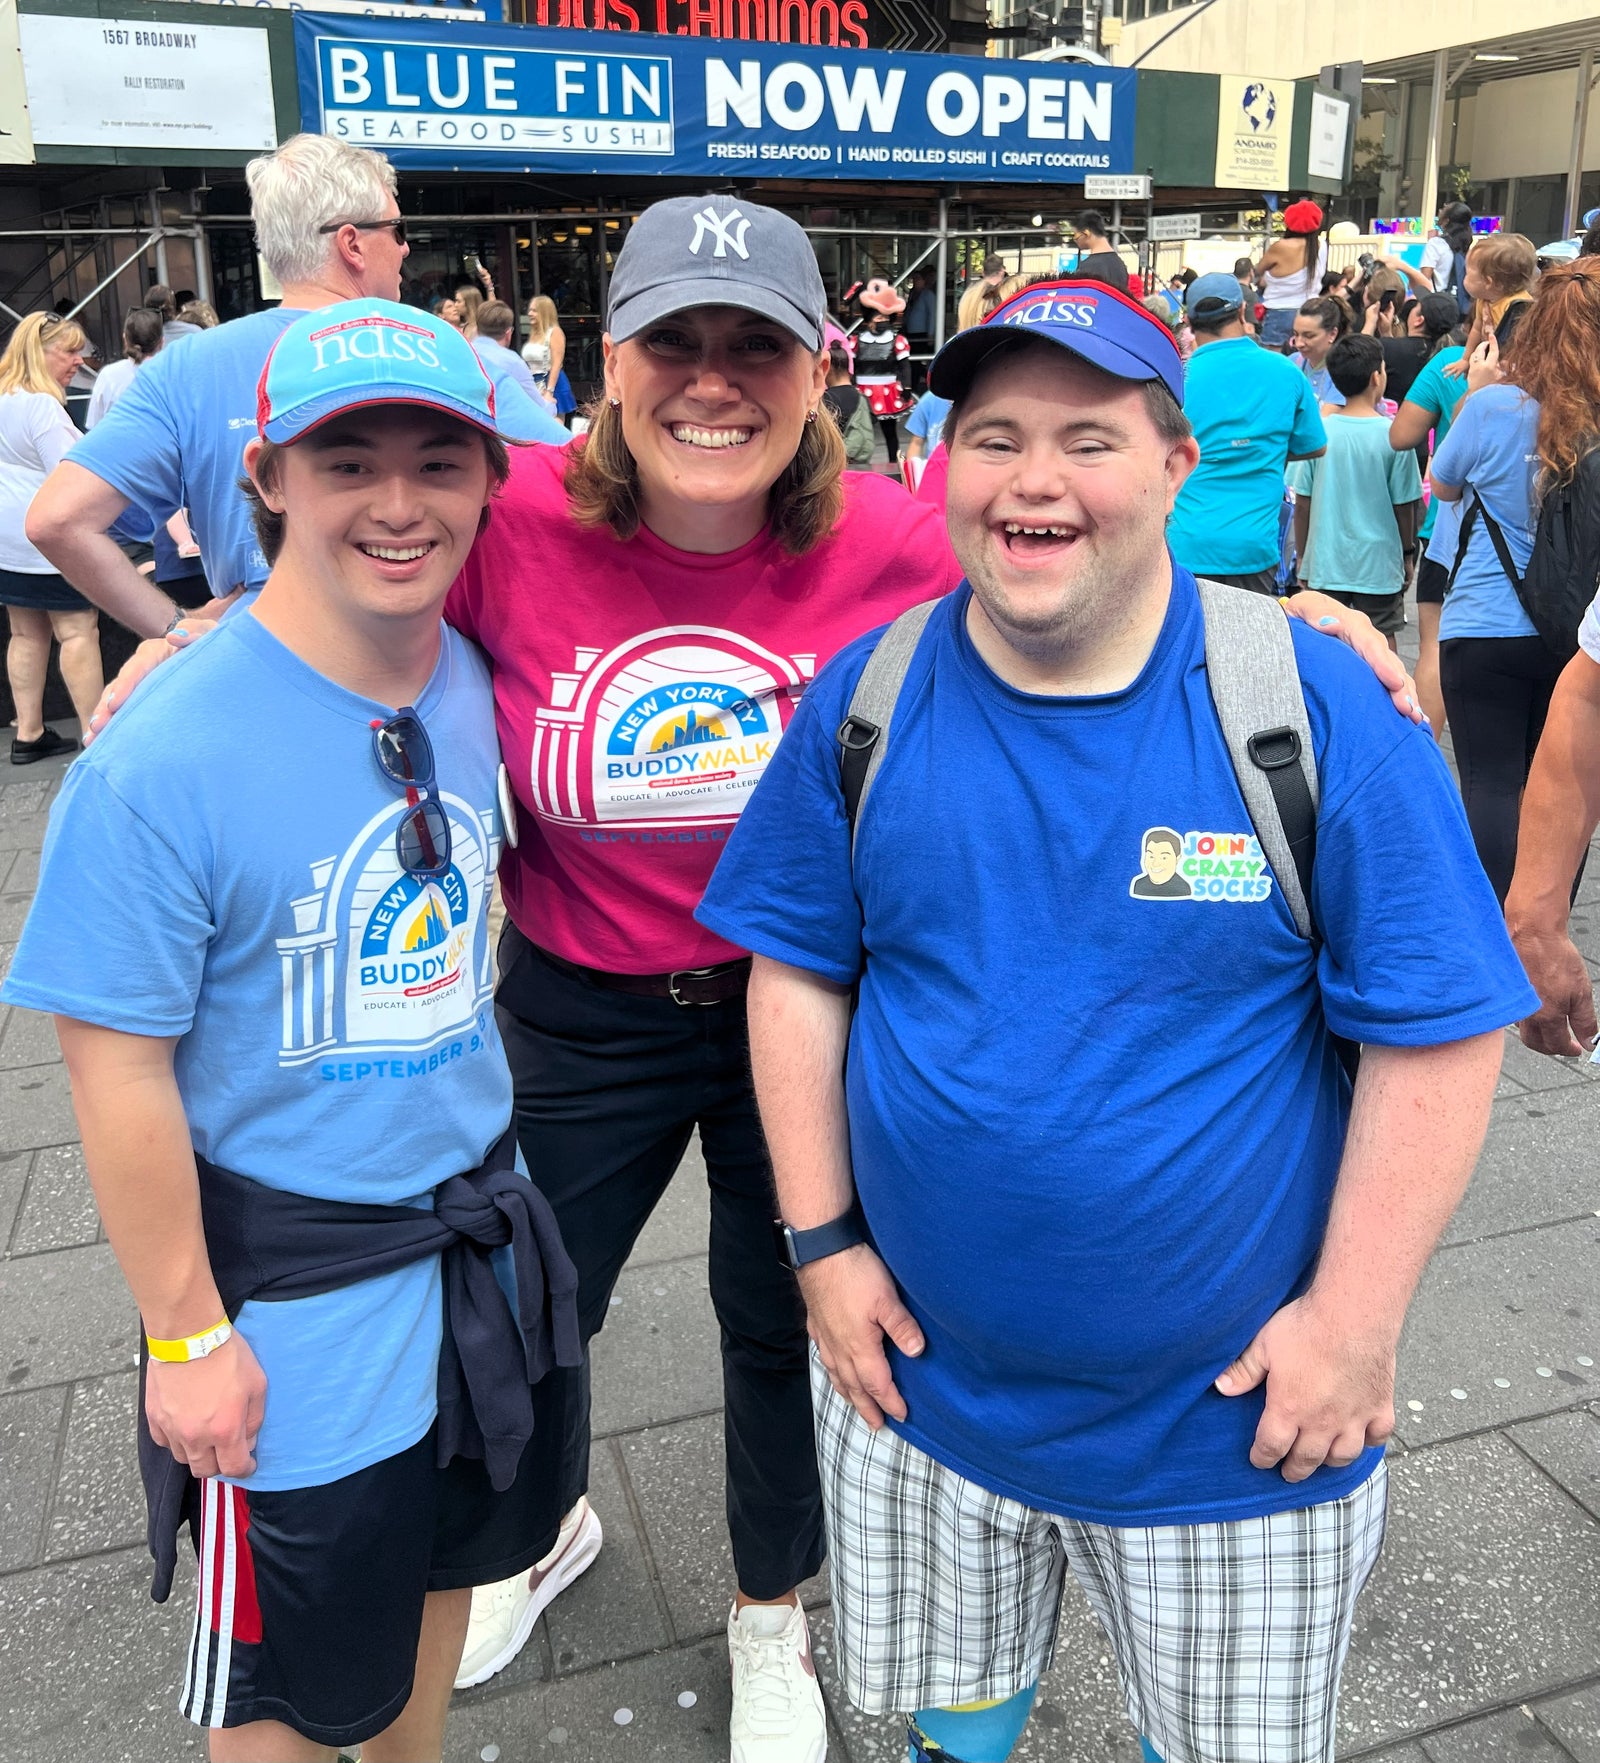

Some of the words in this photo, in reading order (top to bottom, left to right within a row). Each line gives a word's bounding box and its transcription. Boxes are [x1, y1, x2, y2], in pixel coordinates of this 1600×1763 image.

[103, 29, 129, 45] 1567
[135, 31, 198, 49] BROADWAY
[124, 76, 142, 89] RALLY
[144, 77, 186, 91] RESTORATION
[329, 47, 518, 111] BLUE
[555, 59, 661, 117] FIN
[704, 58, 907, 133] NOW
[926, 70, 1113, 142] OPEN
[336, 117, 516, 142] SEAFOOD
[562, 125, 662, 147] SUSHI
[707, 142, 758, 159] FRESH
[759, 143, 831, 161] SEAFOOD
[848, 147, 891, 162] HAND
[893, 148, 946, 164] ROLLED
[948, 150, 987, 165] SUSHI
[1001, 152, 1042, 167] CRAFT
[1044, 153, 1110, 169] COCKTAILS
[688, 206, 751, 260] NY
[617, 696, 659, 742] NEW
[666, 686, 728, 703] YORK
[610, 792, 652, 802] EDUCATE
[665, 786, 713, 798] ADVOCATE
[579, 829, 726, 844] SEPTEMBER
[1182, 858, 1261, 878] CRAZY
[1194, 878, 1267, 898] SOCKS
[368, 885, 408, 941] NEW
[443, 872, 463, 912] CITY
[364, 1001, 407, 1011] EDUCATE
[421, 986, 457, 1007] ADVOCATE
[321, 1041, 463, 1082] SEPTEMBER
